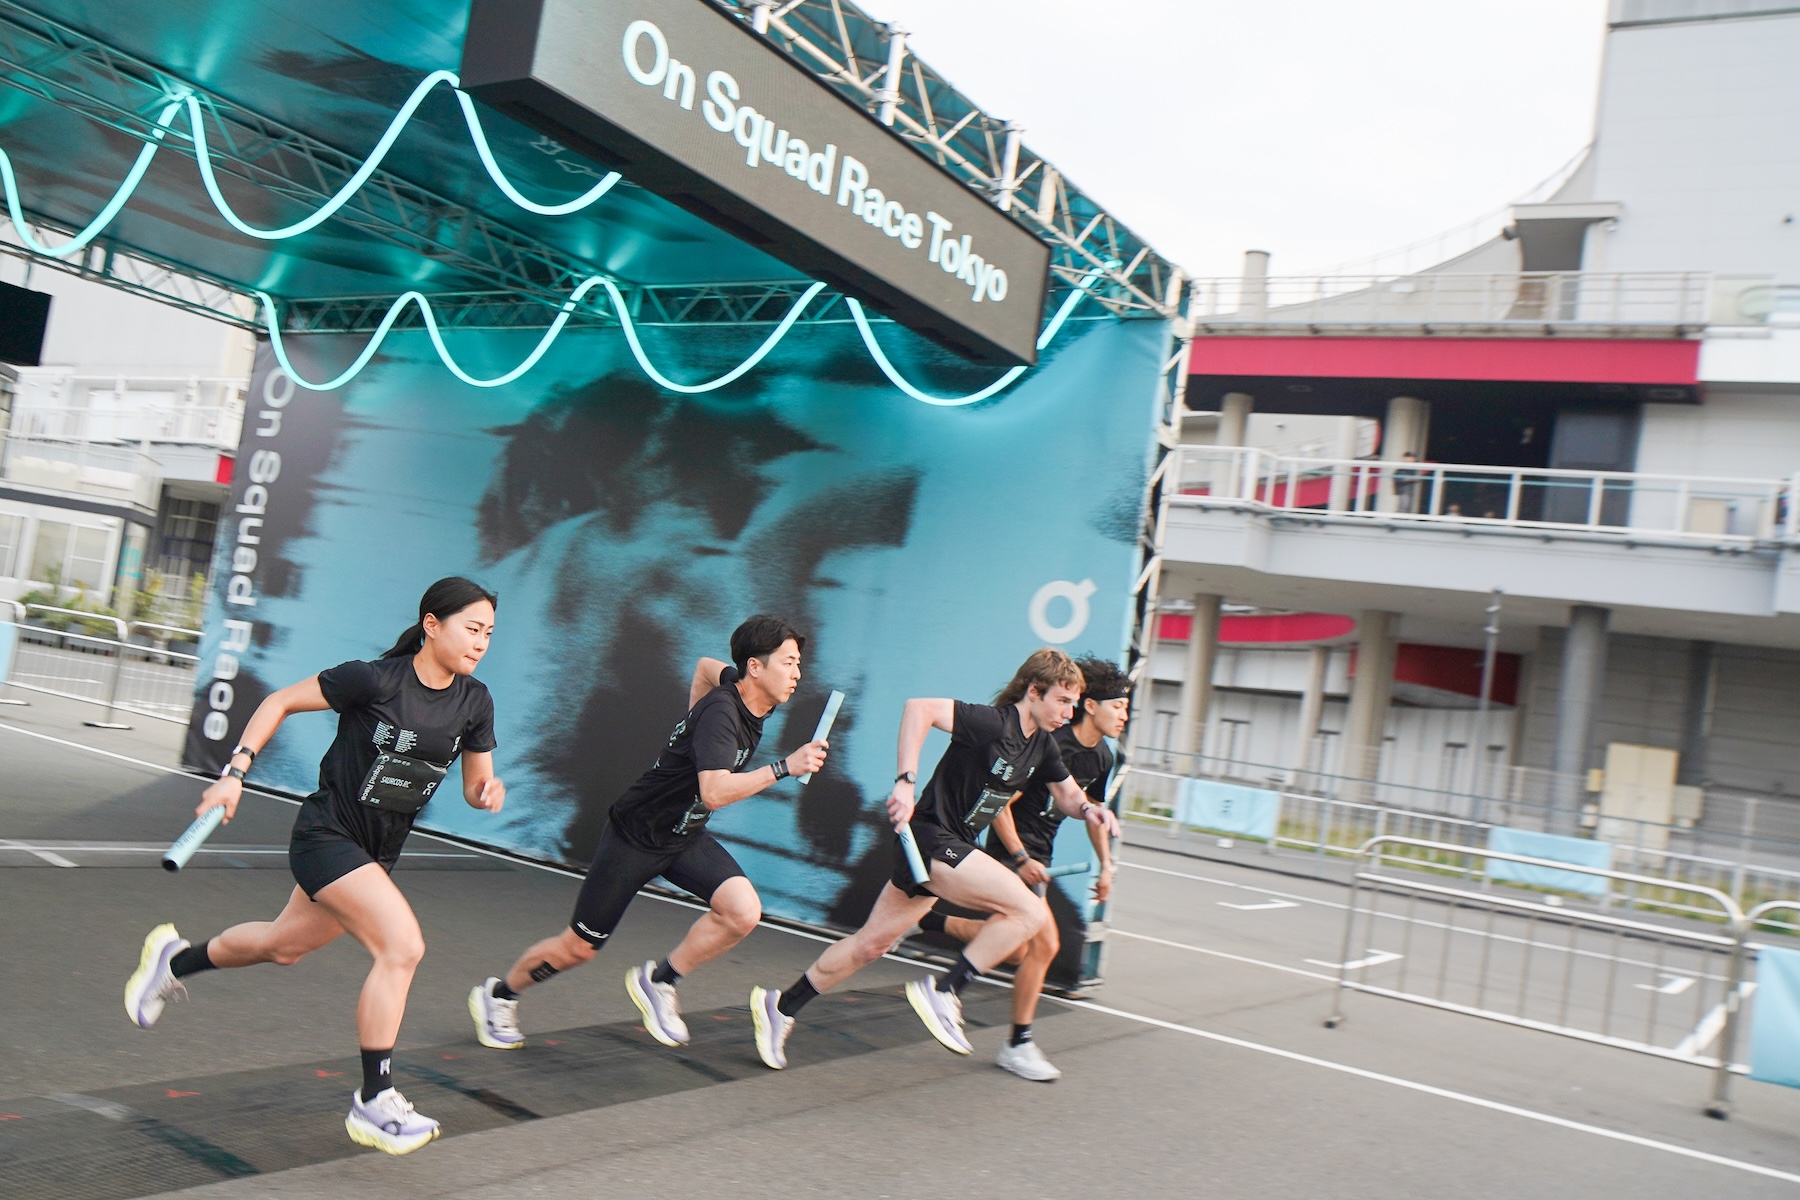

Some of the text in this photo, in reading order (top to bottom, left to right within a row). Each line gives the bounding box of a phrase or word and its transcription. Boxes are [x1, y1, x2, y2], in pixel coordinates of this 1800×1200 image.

[621, 20, 1008, 302] On Squad Race Tokyo
[203, 366, 296, 741] On Squad Race
